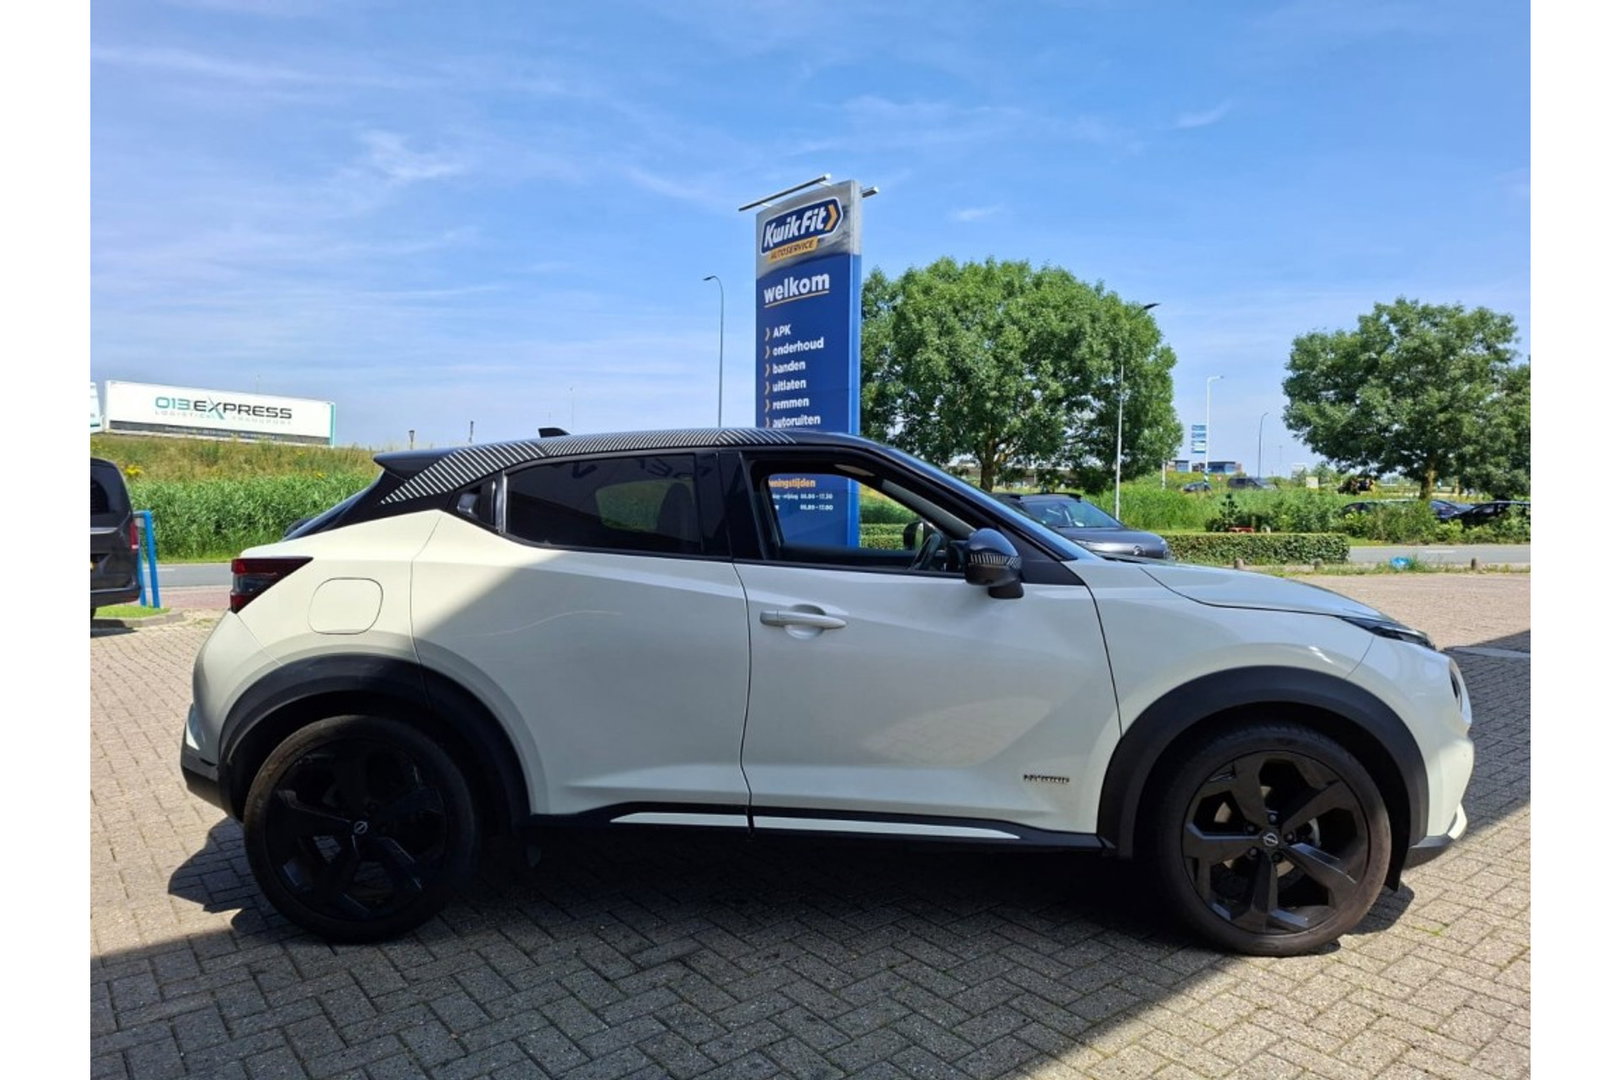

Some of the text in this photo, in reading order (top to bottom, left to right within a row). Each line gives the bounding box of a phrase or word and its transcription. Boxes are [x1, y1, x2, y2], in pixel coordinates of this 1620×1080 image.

[770, 240, 815, 260] AUTOSERVICE
[763, 273, 830, 304] welkom
[773, 324, 792, 338] APK
[772, 337, 824, 356] onderhoud
[772, 360, 806, 375] banden
[772, 379, 807, 393] uitlaten
[772, 397, 810, 411] remmen
[772, 415, 821, 429] autoruiten
